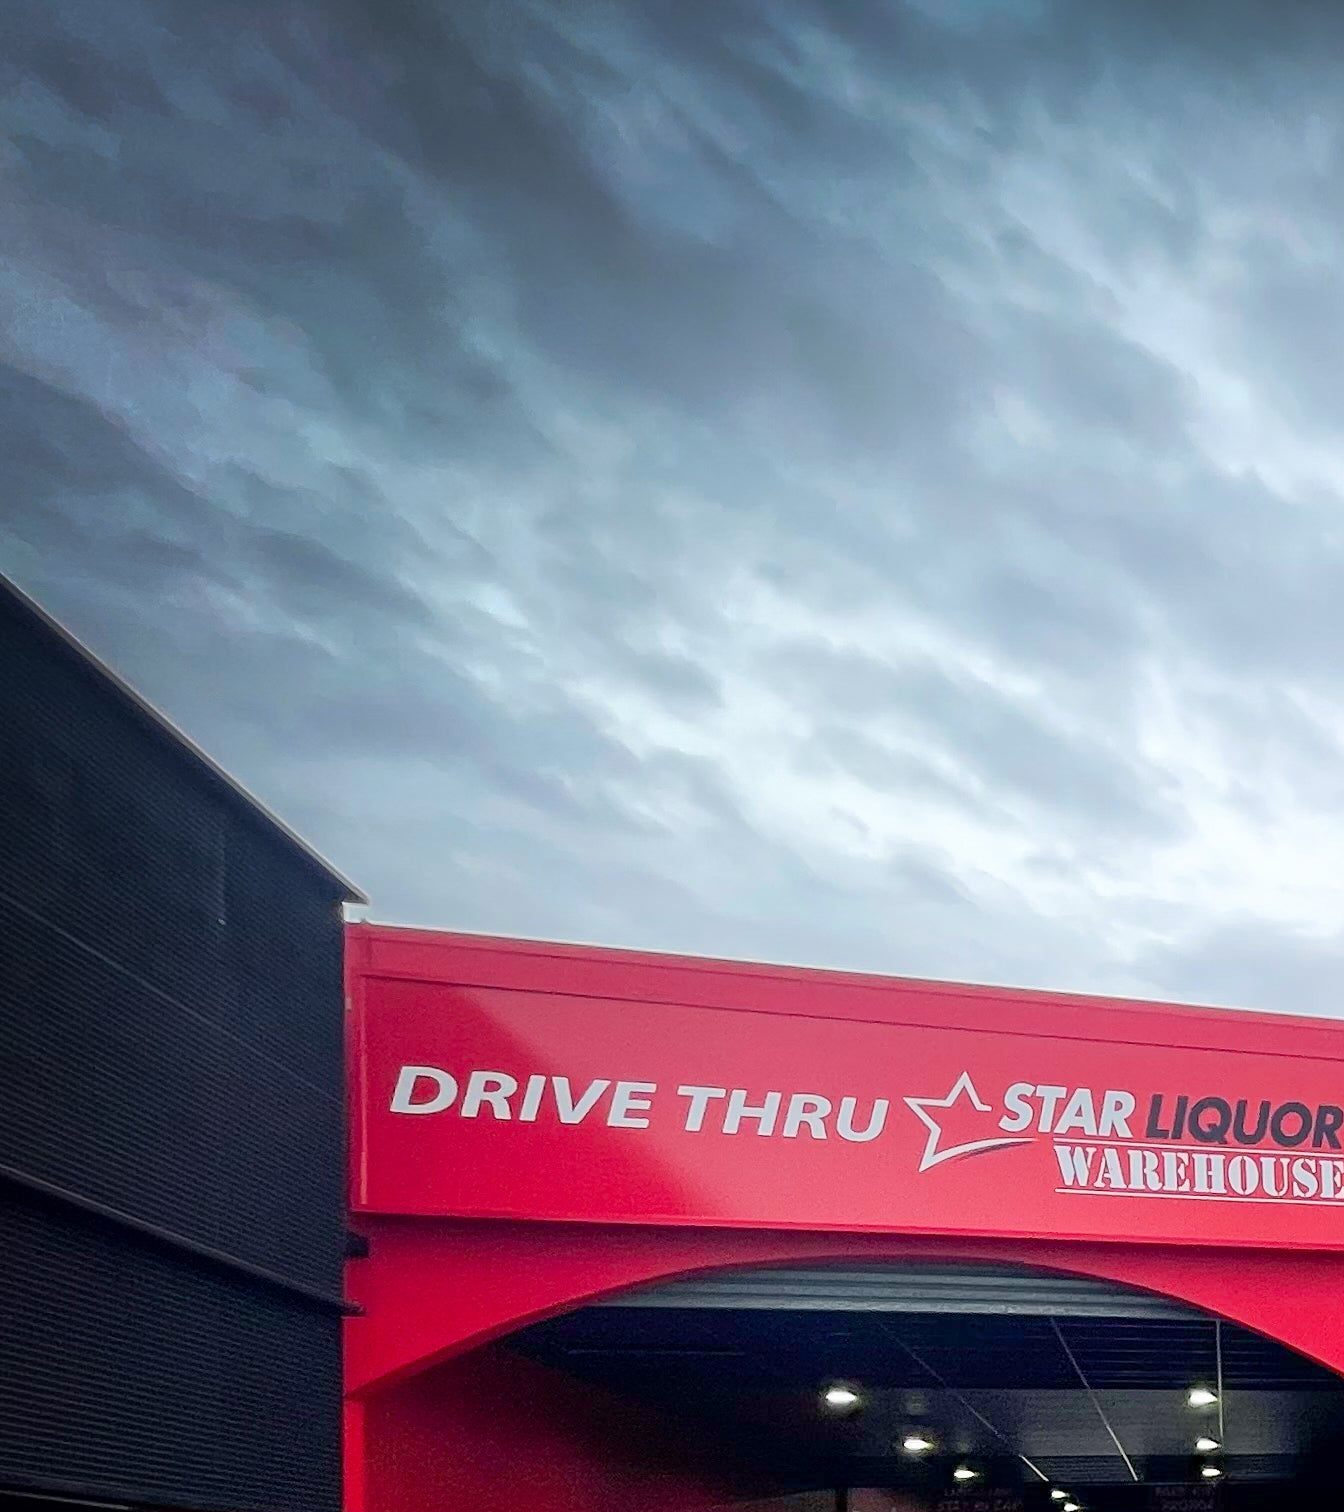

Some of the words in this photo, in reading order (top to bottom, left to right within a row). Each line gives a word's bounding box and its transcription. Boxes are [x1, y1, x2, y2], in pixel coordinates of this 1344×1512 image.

[389, 1065, 657, 1129] DRIVE
[676, 1085, 890, 1143] THRU
[998, 1082, 1136, 1139] STAR
[1146, 1094, 1344, 1150] LIQUOR
